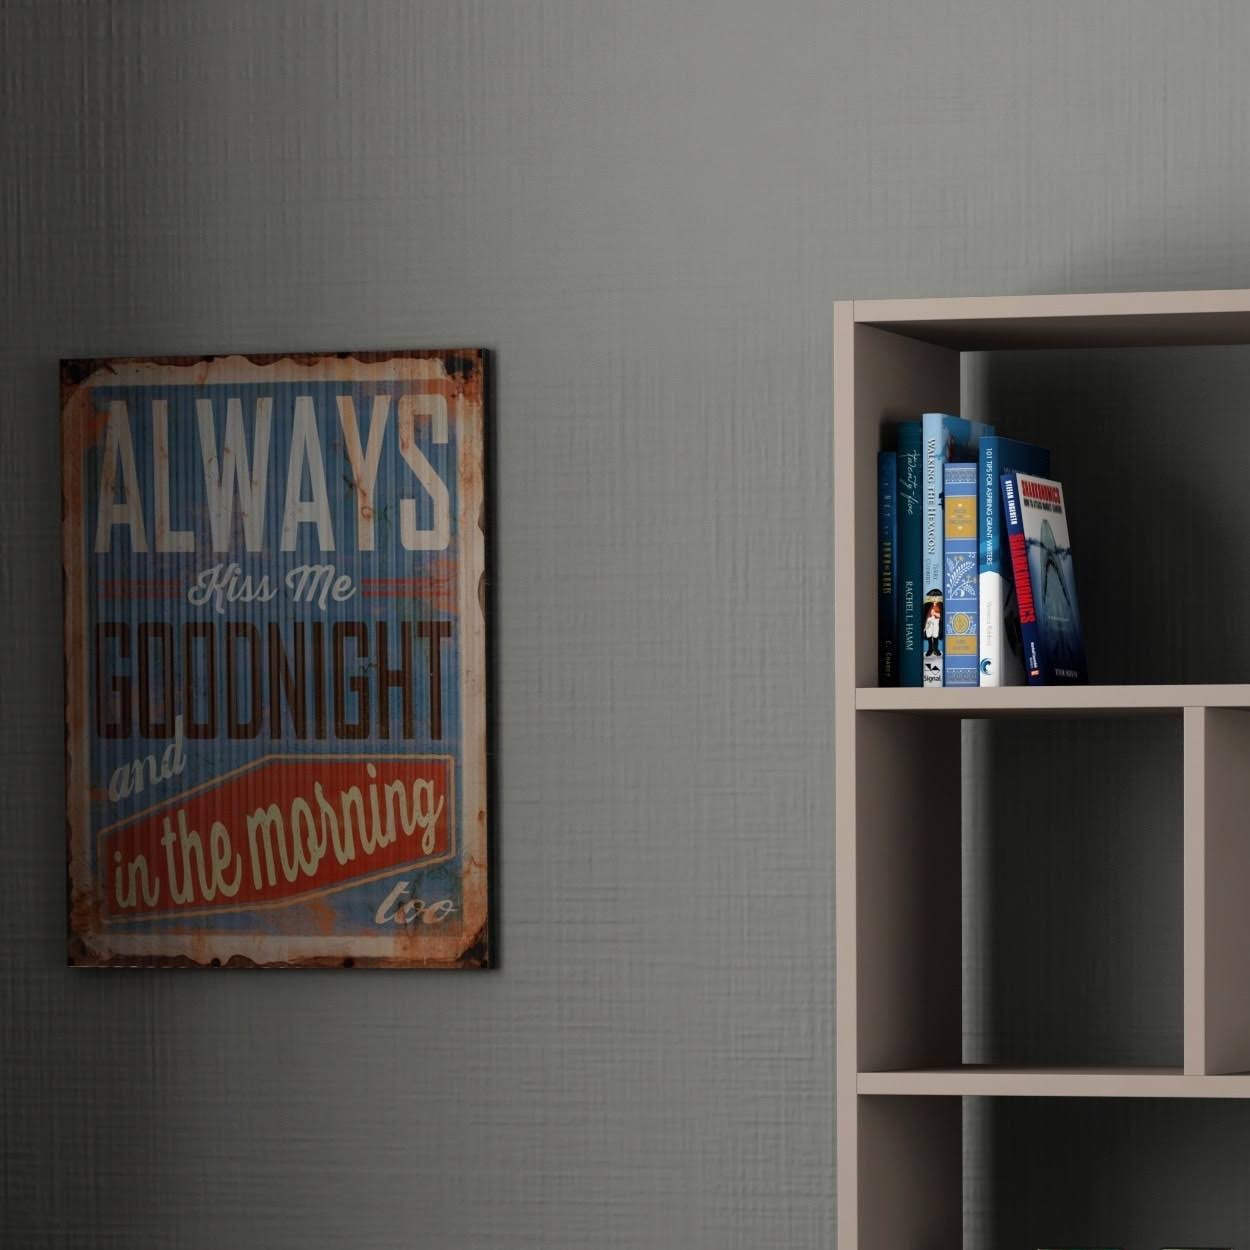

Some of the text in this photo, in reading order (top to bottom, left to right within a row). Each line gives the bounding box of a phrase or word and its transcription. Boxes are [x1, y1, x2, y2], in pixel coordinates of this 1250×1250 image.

[94, 393, 451, 553] ALWAYS
[927, 439, 936, 555] WALKING THE HEXAGON
[986, 448, 994, 566] 101 TIPS FOR ASPIRING GRANT WRITERS
[187, 562, 357, 614] Kiss Me
[905, 581, 914, 613] RACHEL
[1009, 533, 1036, 625] SHARKONOMICS
[96, 620, 453, 742] GOODNIGHT
[905, 624, 914, 651] HAMM
[924, 675, 942, 684] Signal
[108, 714, 187, 802] and
[113, 763, 445, 910] in the morning
[374, 880, 458, 926] too
